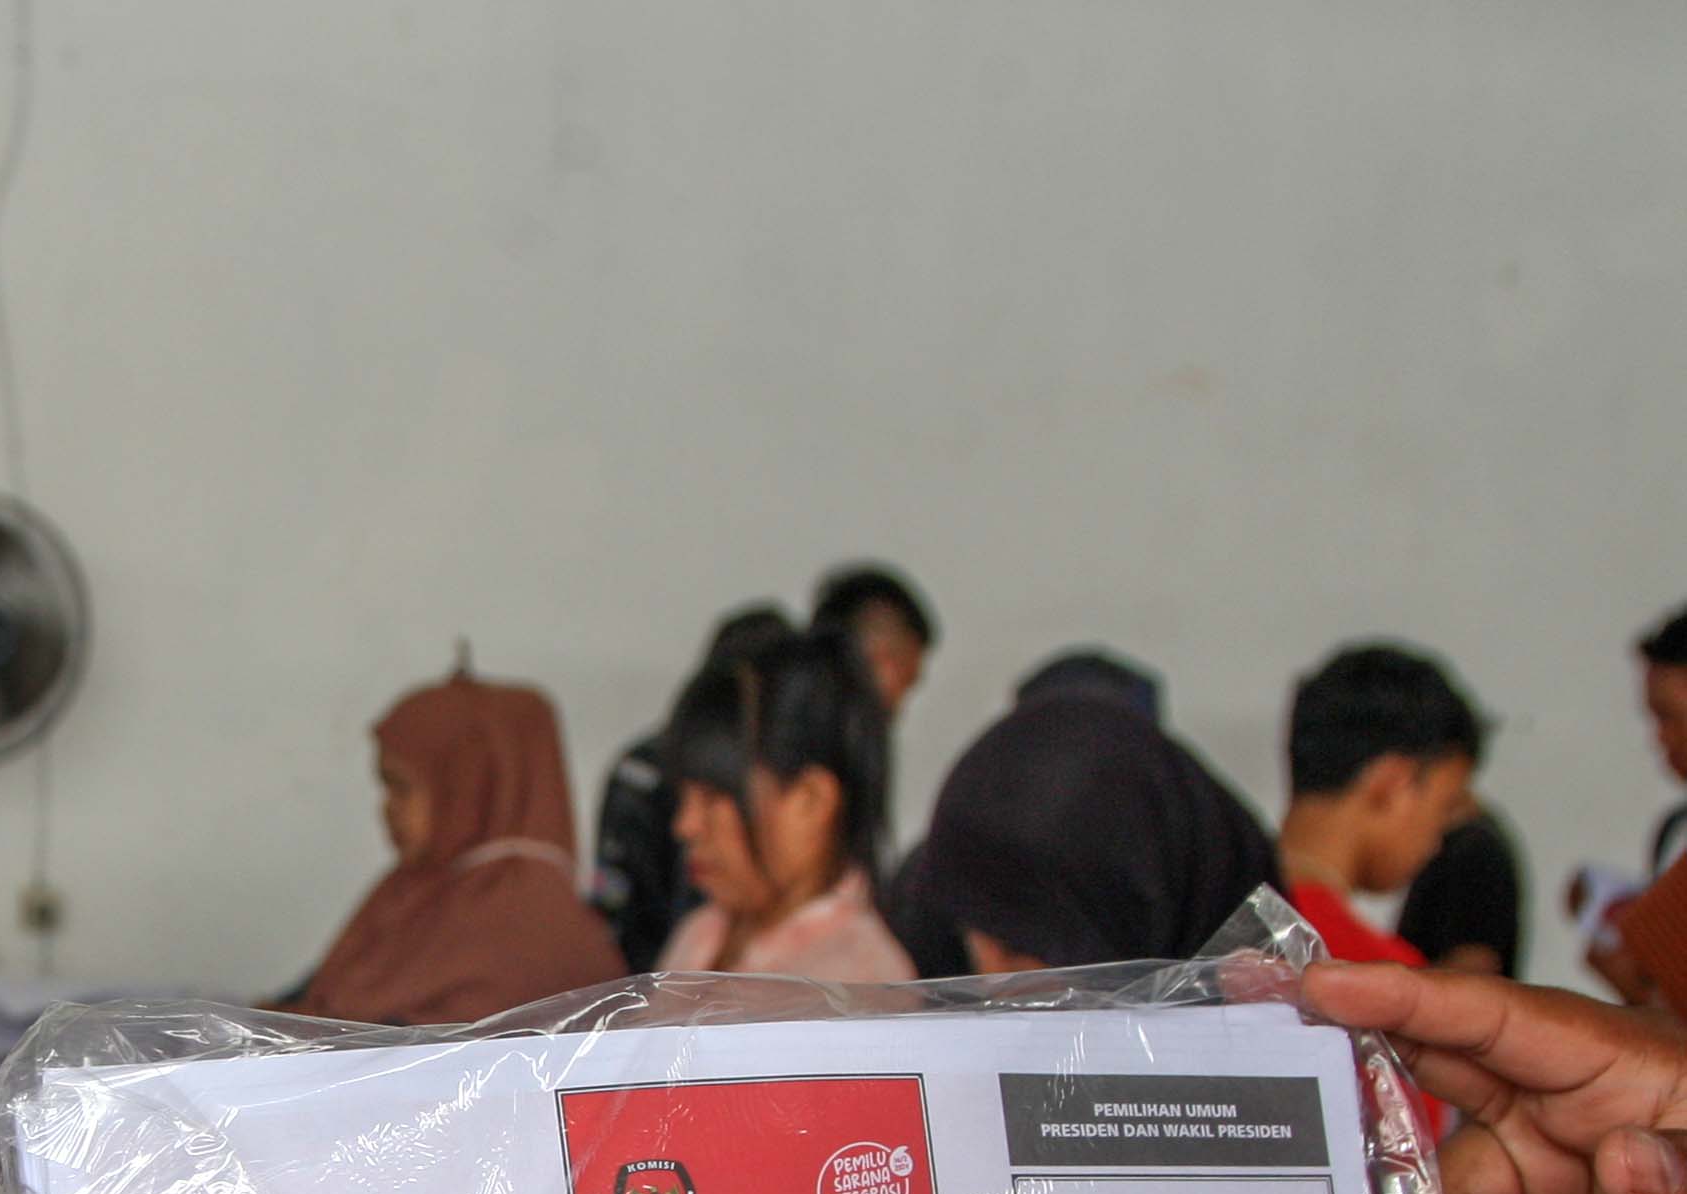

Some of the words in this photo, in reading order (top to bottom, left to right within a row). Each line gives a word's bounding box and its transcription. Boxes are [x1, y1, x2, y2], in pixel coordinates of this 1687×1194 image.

[1093, 1103, 1182, 1118] PEMILIHAN
[1185, 1103, 1238, 1118] UMUM
[1040, 1123, 1120, 1138] PRESIDEN
[1123, 1123, 1160, 1138] DAN
[1162, 1123, 1215, 1139] WAKIL
[1217, 1124, 1293, 1139] PRESIDEN
[626, 1160, 675, 1173] KOMISI
[833, 1151, 887, 1175] PEMILU
[834, 1166, 891, 1193] SARANA
